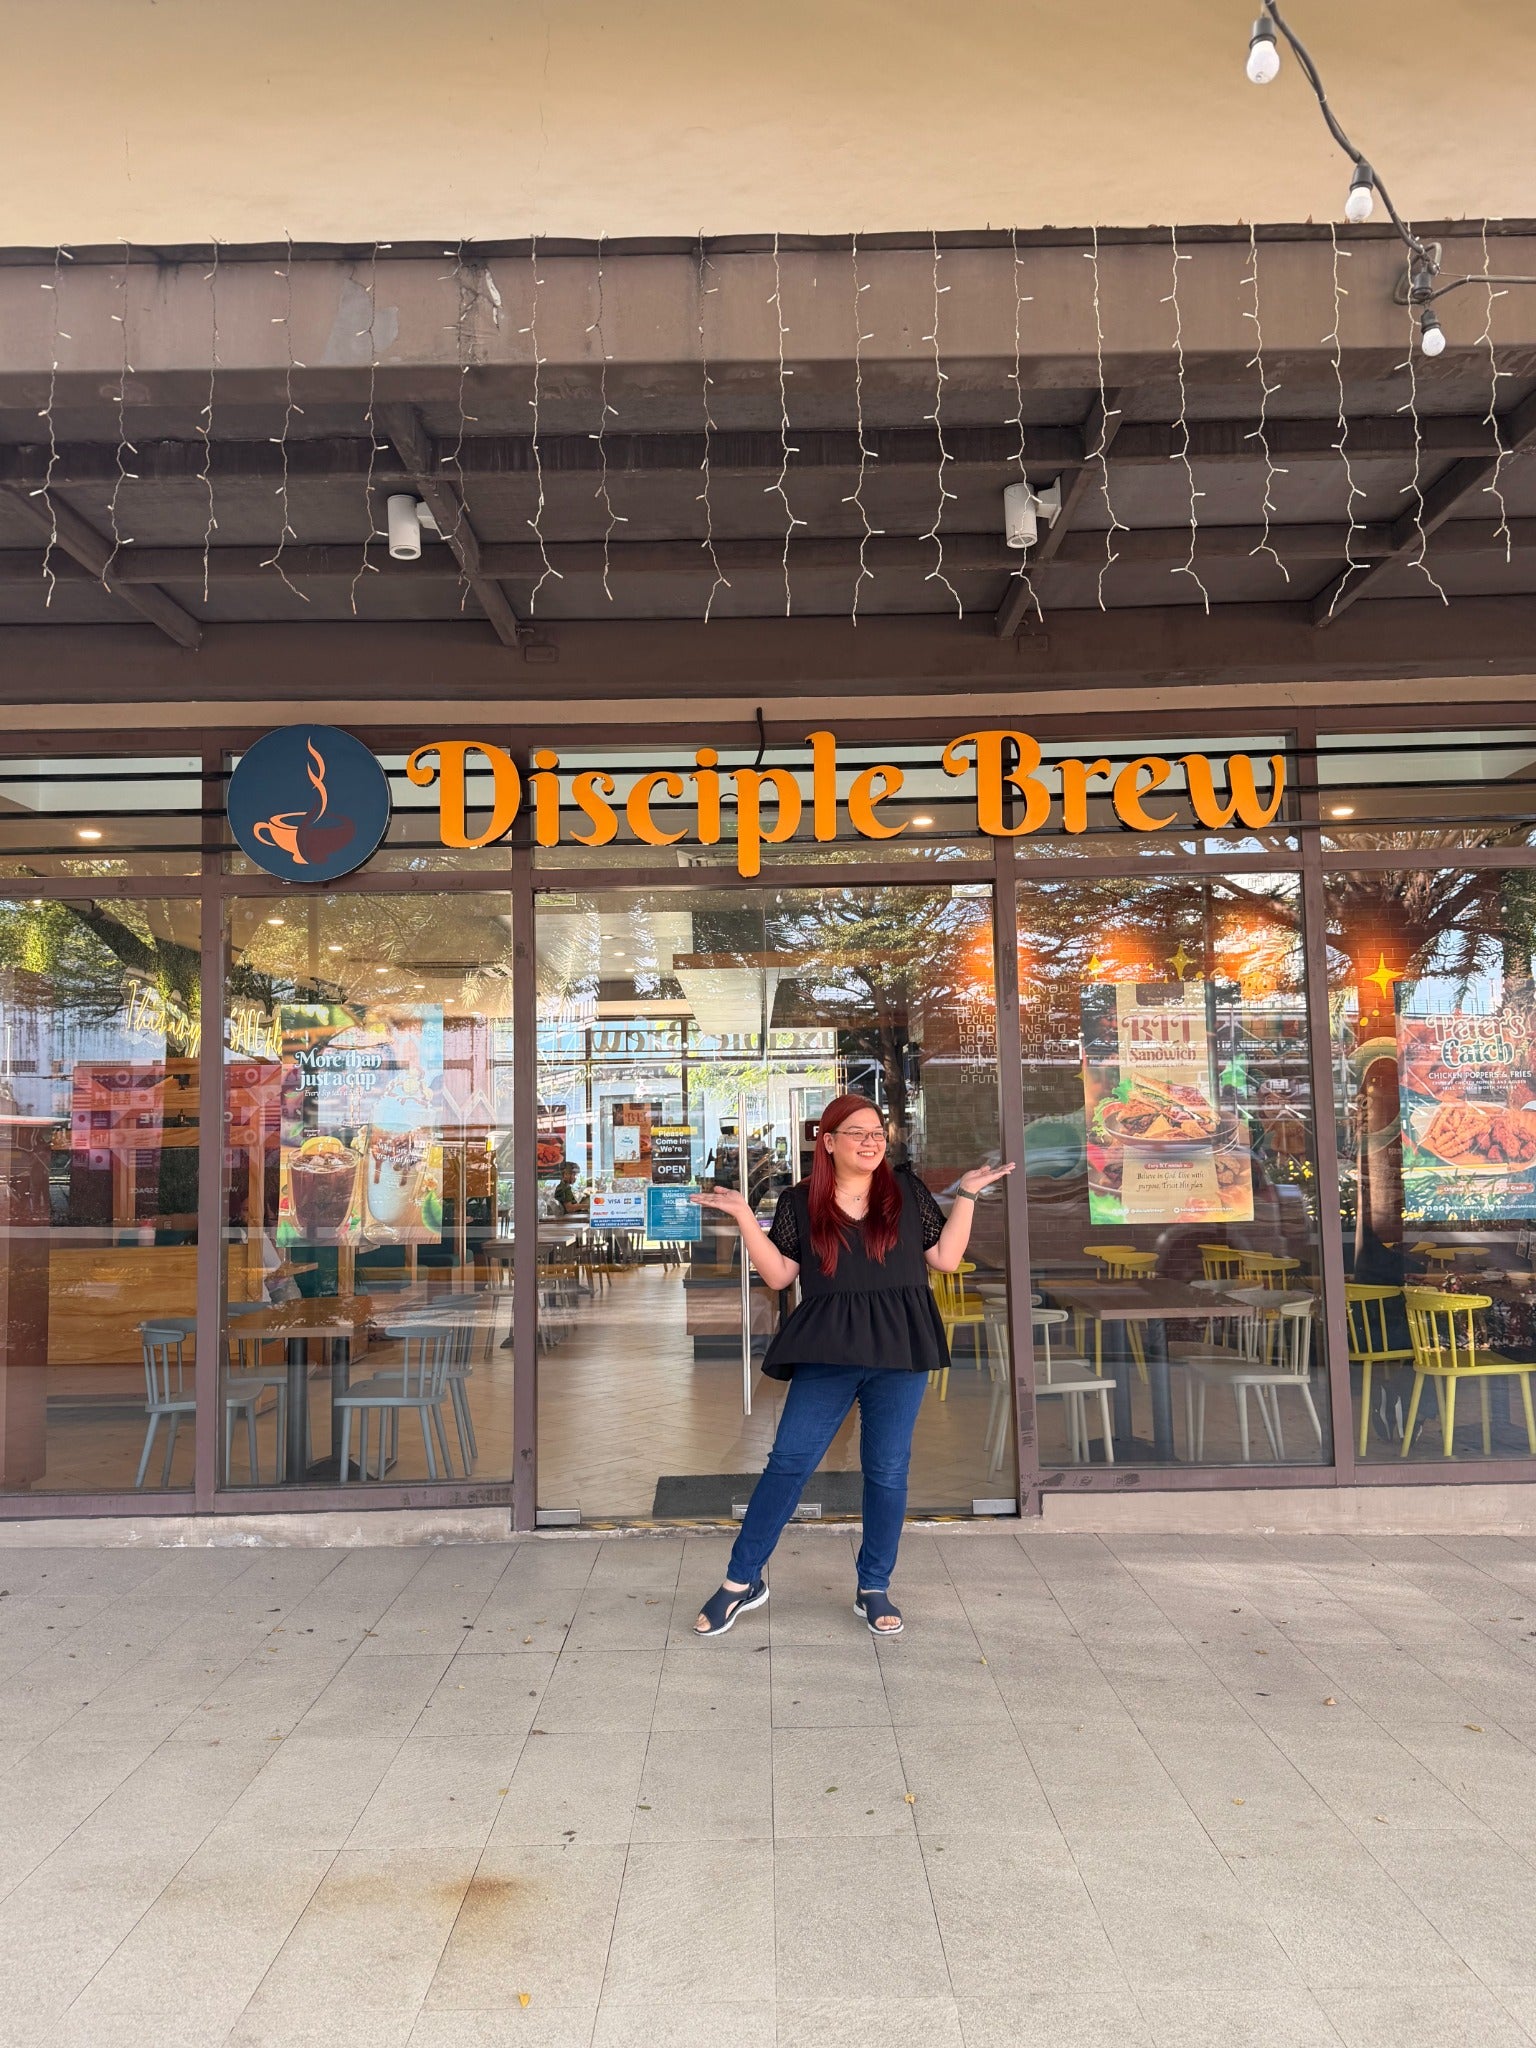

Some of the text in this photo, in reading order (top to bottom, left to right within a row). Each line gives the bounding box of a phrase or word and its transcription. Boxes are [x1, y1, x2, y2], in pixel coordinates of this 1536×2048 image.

[406, 730, 1285, 878] Disciple Brew
[1028, 985, 1070, 994] KNOW
[1050, 1024, 1067, 1033] TO
[1425, 1008, 1526, 1042] Peter's
[960, 1045, 982, 1054] NOT
[1442, 1034, 1514, 1069] Catch
[294, 1047, 383, 1069] More than
[1129, 1047, 1197, 1063] Sandwich
[960, 1075, 968, 1084] A
[1428, 1071, 1463, 1080] CHICKEN
[1465, 1071, 1500, 1079] POPPERS
[1510, 1070, 1532, 1078] FRIES
[295, 1070, 377, 1091] just a cup
[660, 1145, 683, 1153] We're
[657, 1165, 686, 1175] OPEN
[1136, 1172, 1156, 1180] Believe
[1191, 1171, 1204, 1179] with
[1162, 1181, 1178, 1189] Trust
